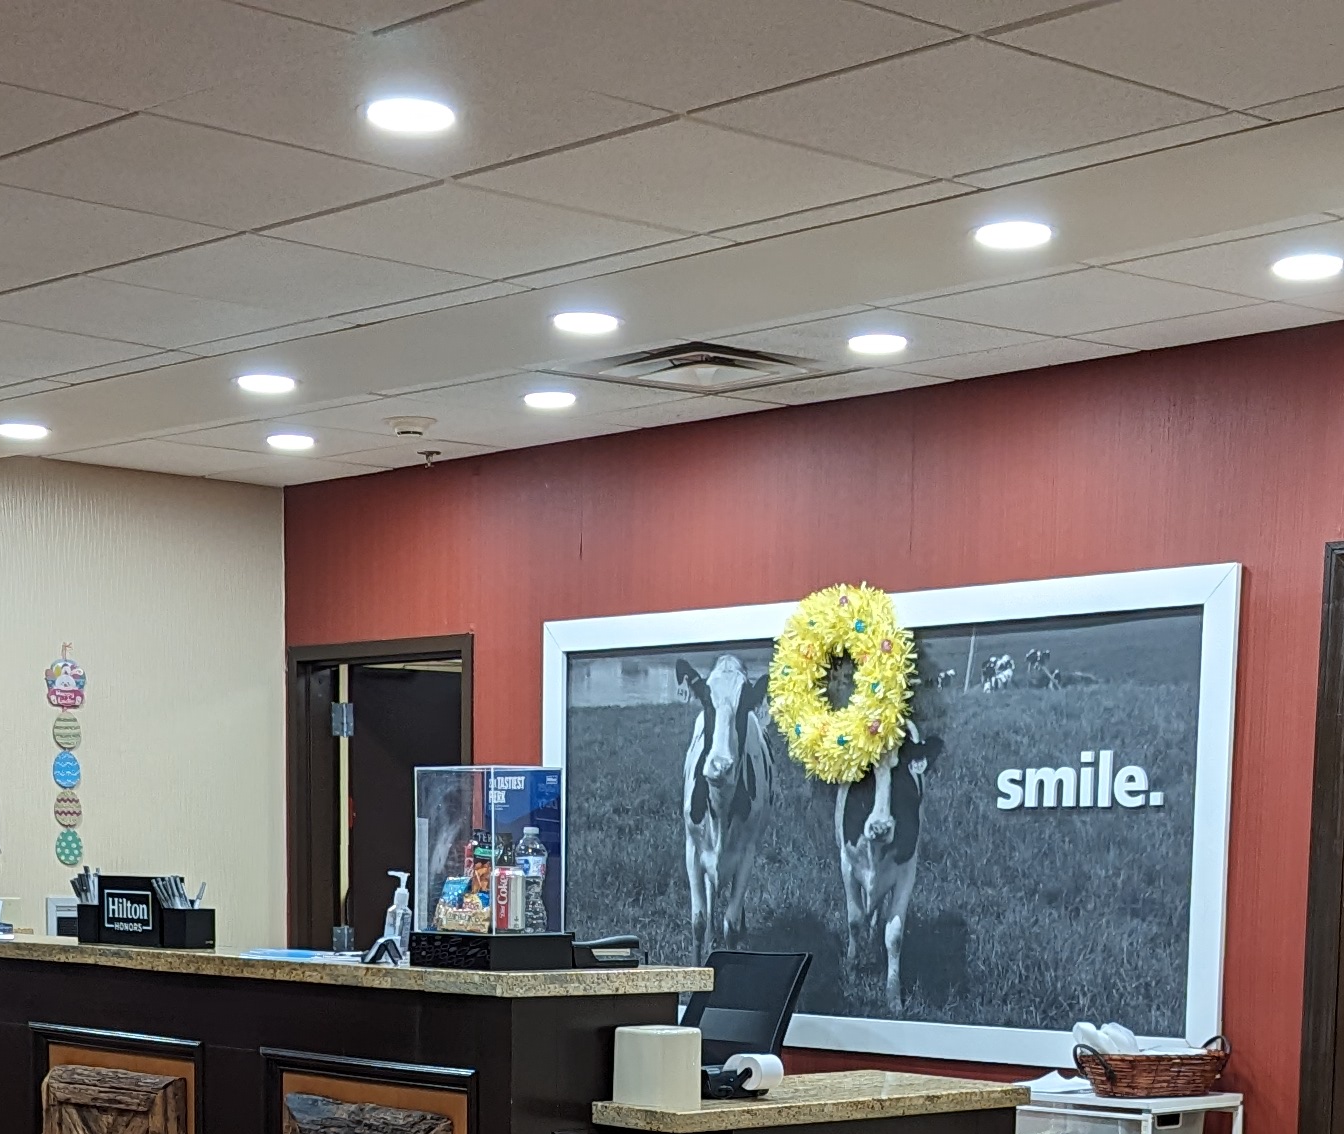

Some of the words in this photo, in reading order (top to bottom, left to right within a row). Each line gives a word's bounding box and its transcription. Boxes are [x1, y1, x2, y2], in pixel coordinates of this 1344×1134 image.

[997, 750, 1164, 810] smile.
[498, 875, 509, 905] Coke
[108, 897, 148, 920] Hilton
[114, 922, 143, 932] HONORS
